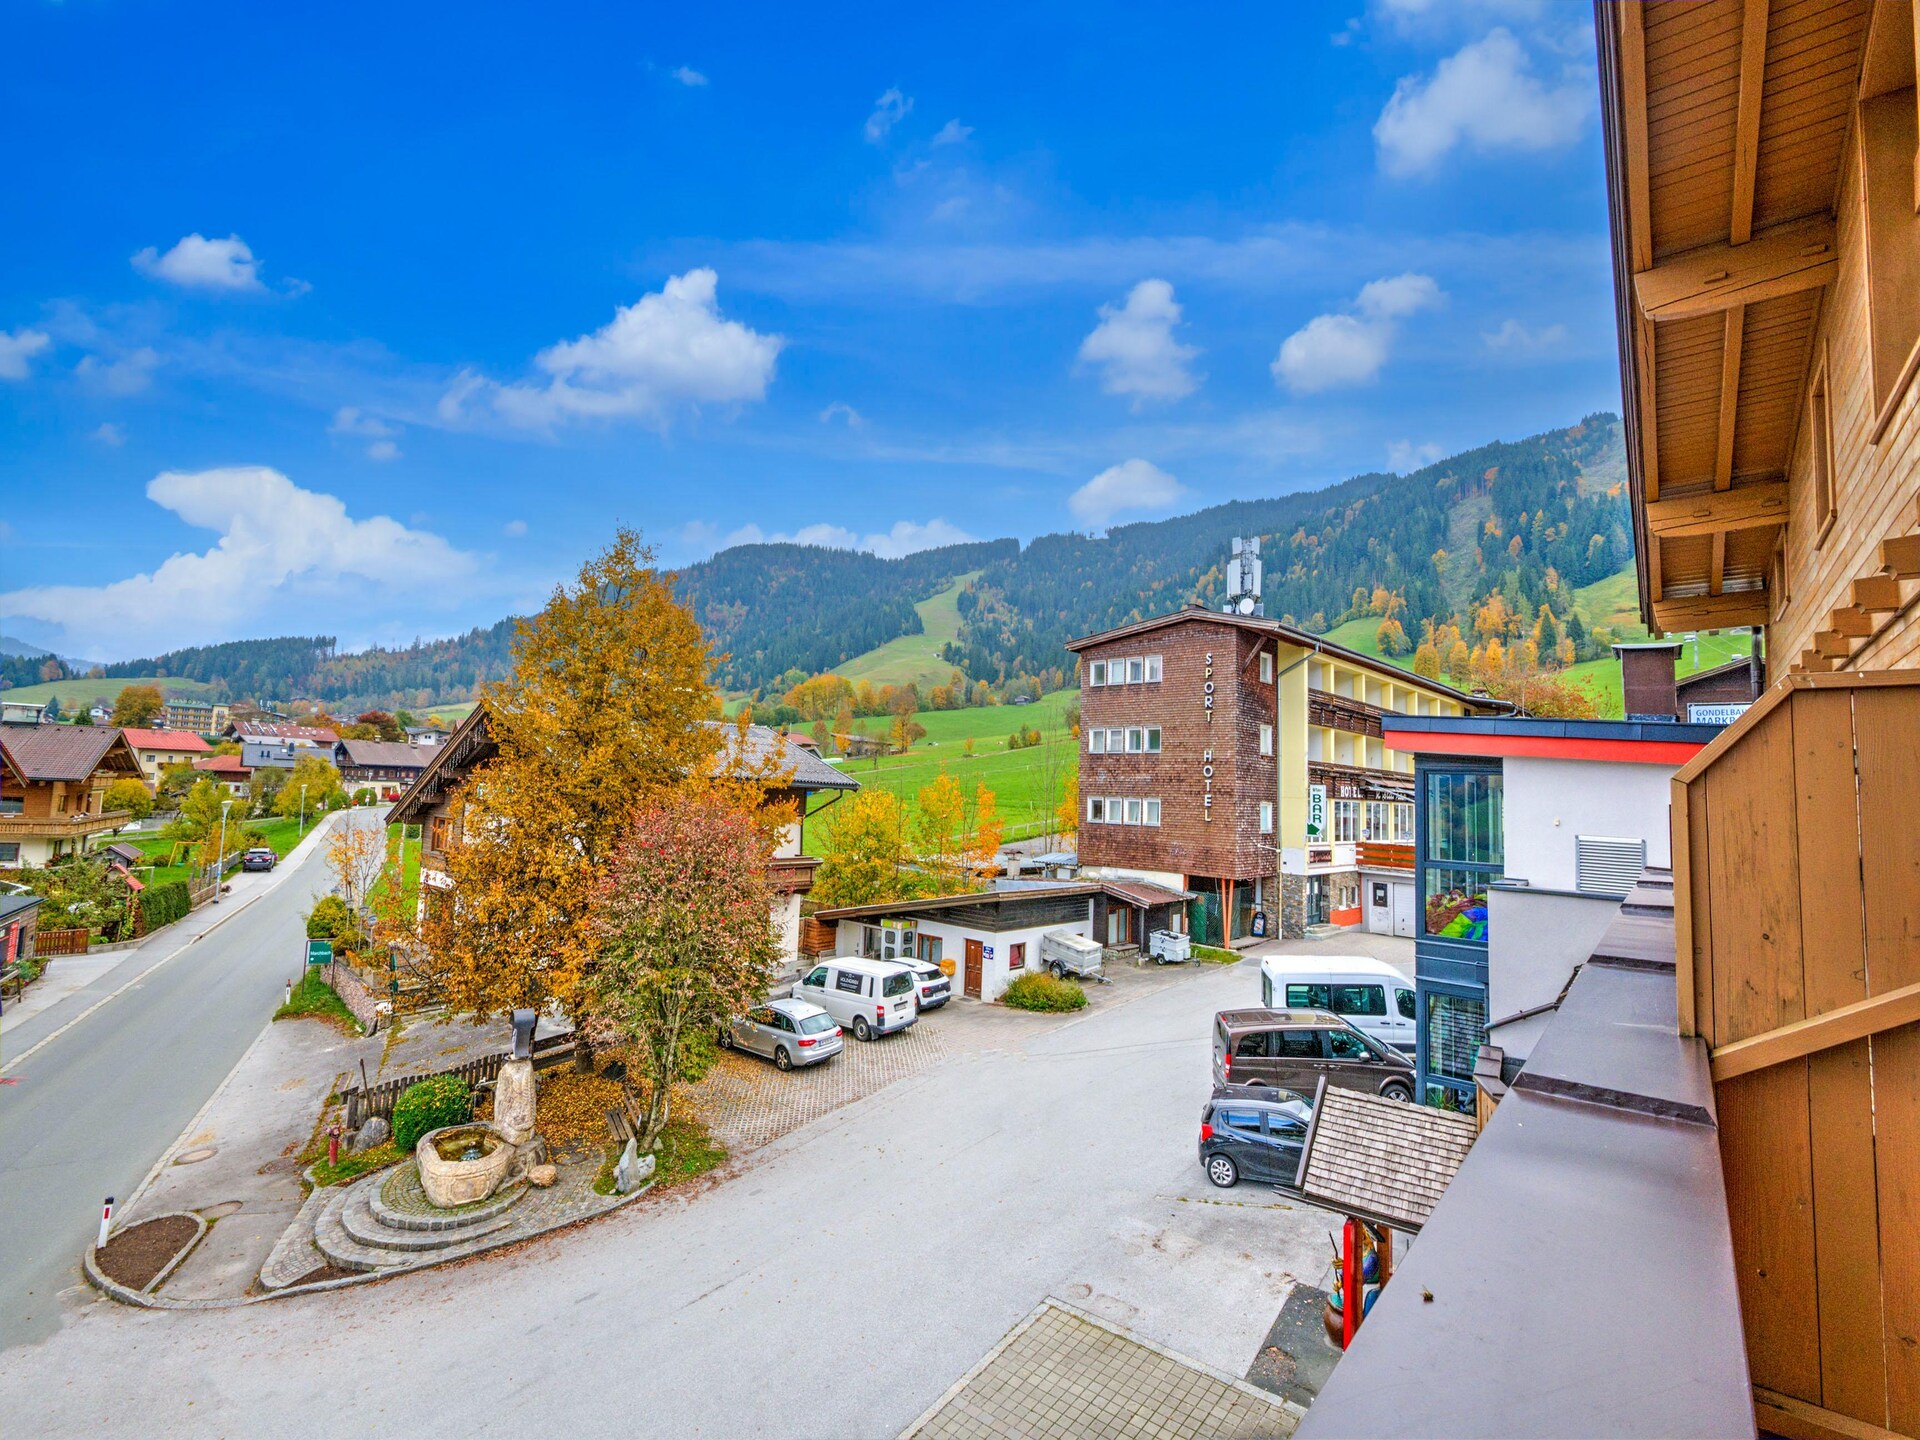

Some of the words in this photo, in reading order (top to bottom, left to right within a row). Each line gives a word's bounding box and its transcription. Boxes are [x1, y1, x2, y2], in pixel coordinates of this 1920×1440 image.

[1204, 652, 1214, 722] SPORT
[1203, 750, 1213, 821] HOTEL
[1312, 793, 1322, 823] BAR
[1340, 785, 1361, 798] HOTEL
